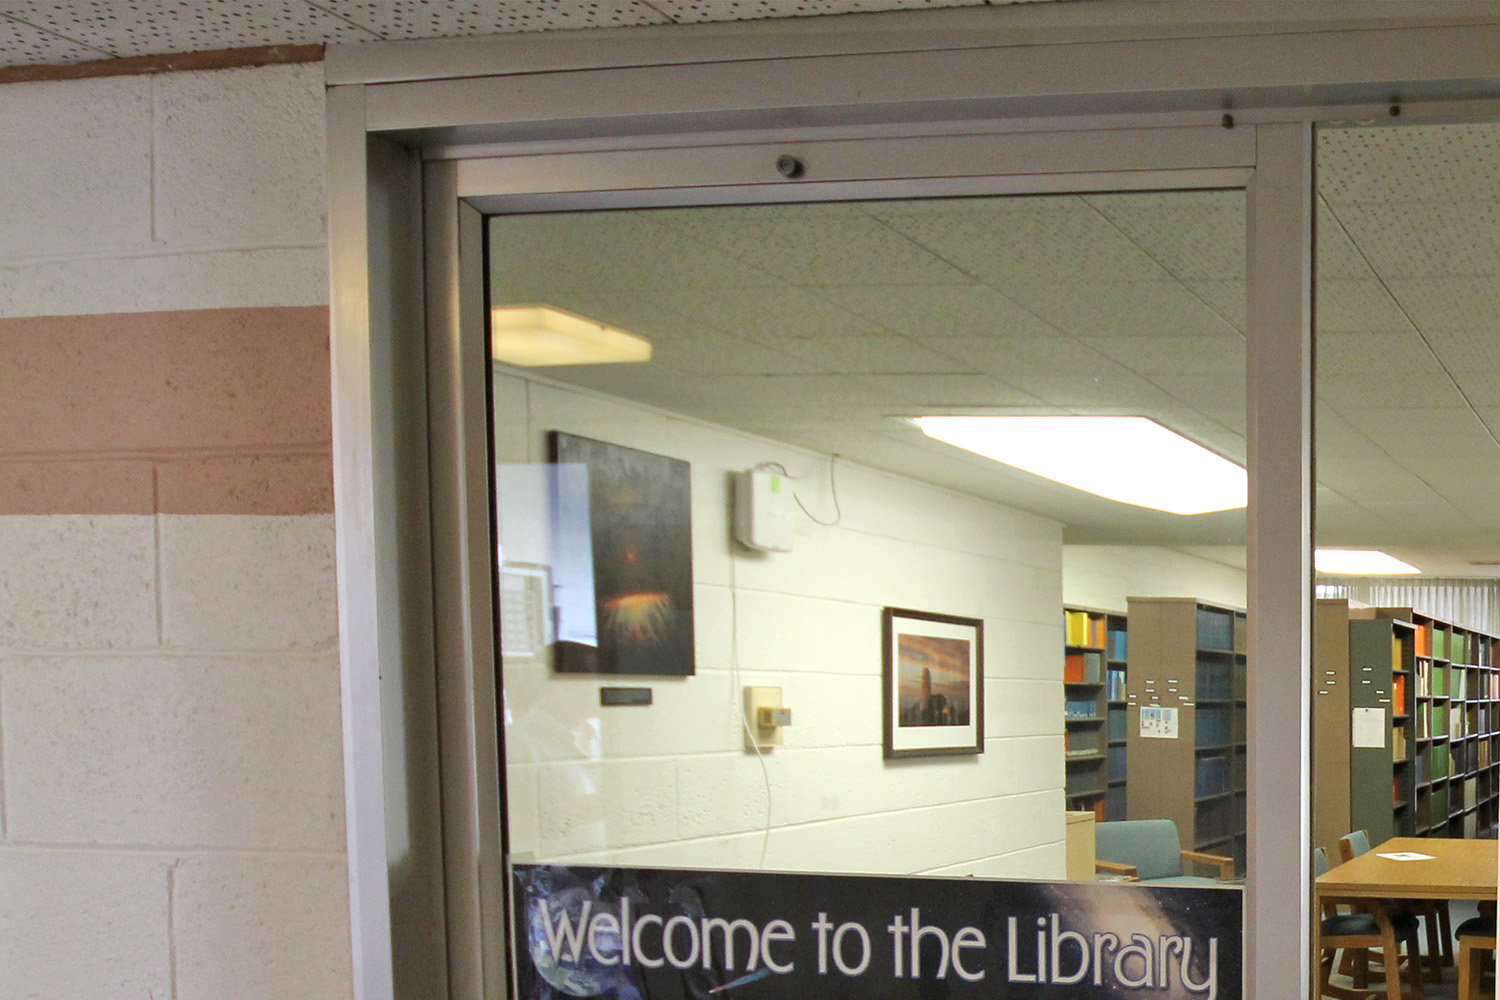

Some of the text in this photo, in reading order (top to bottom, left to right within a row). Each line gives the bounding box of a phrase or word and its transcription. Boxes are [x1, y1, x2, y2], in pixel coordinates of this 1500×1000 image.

[536, 896, 796, 974] Welcome
[811, 911, 872, 977] to
[887, 907, 986, 981] the
